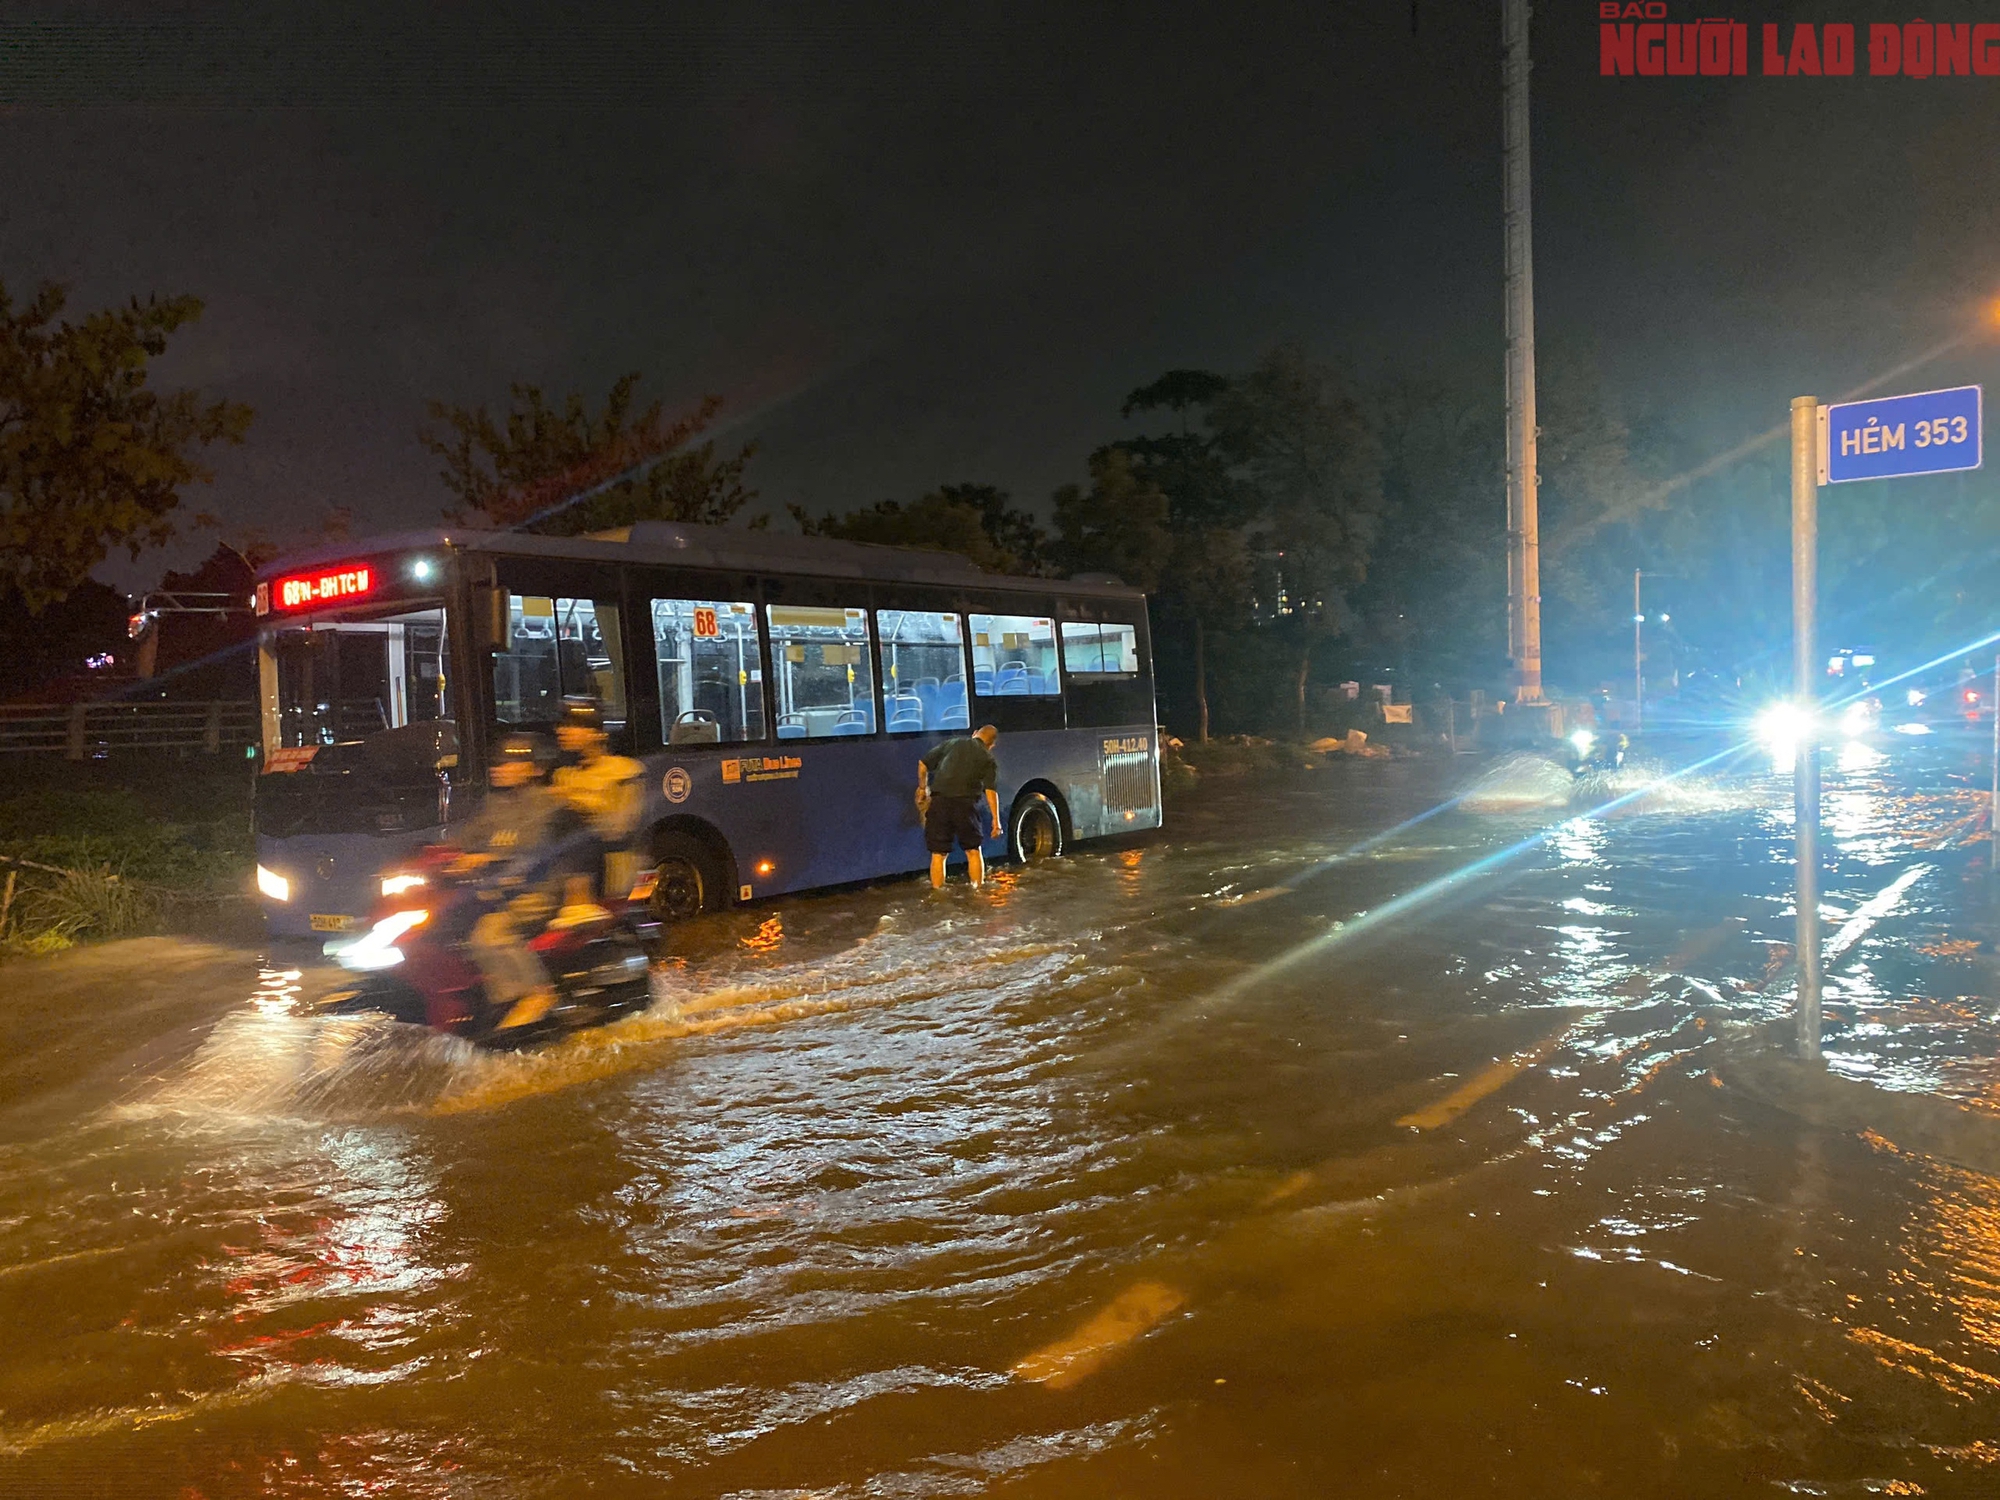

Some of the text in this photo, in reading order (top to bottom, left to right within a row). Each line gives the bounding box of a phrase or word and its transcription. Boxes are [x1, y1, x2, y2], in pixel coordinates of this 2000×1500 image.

[1841, 416, 1968, 456] HẺM 353
[695, 611, 715, 636] 68
[740, 758, 763, 772] FUTA
